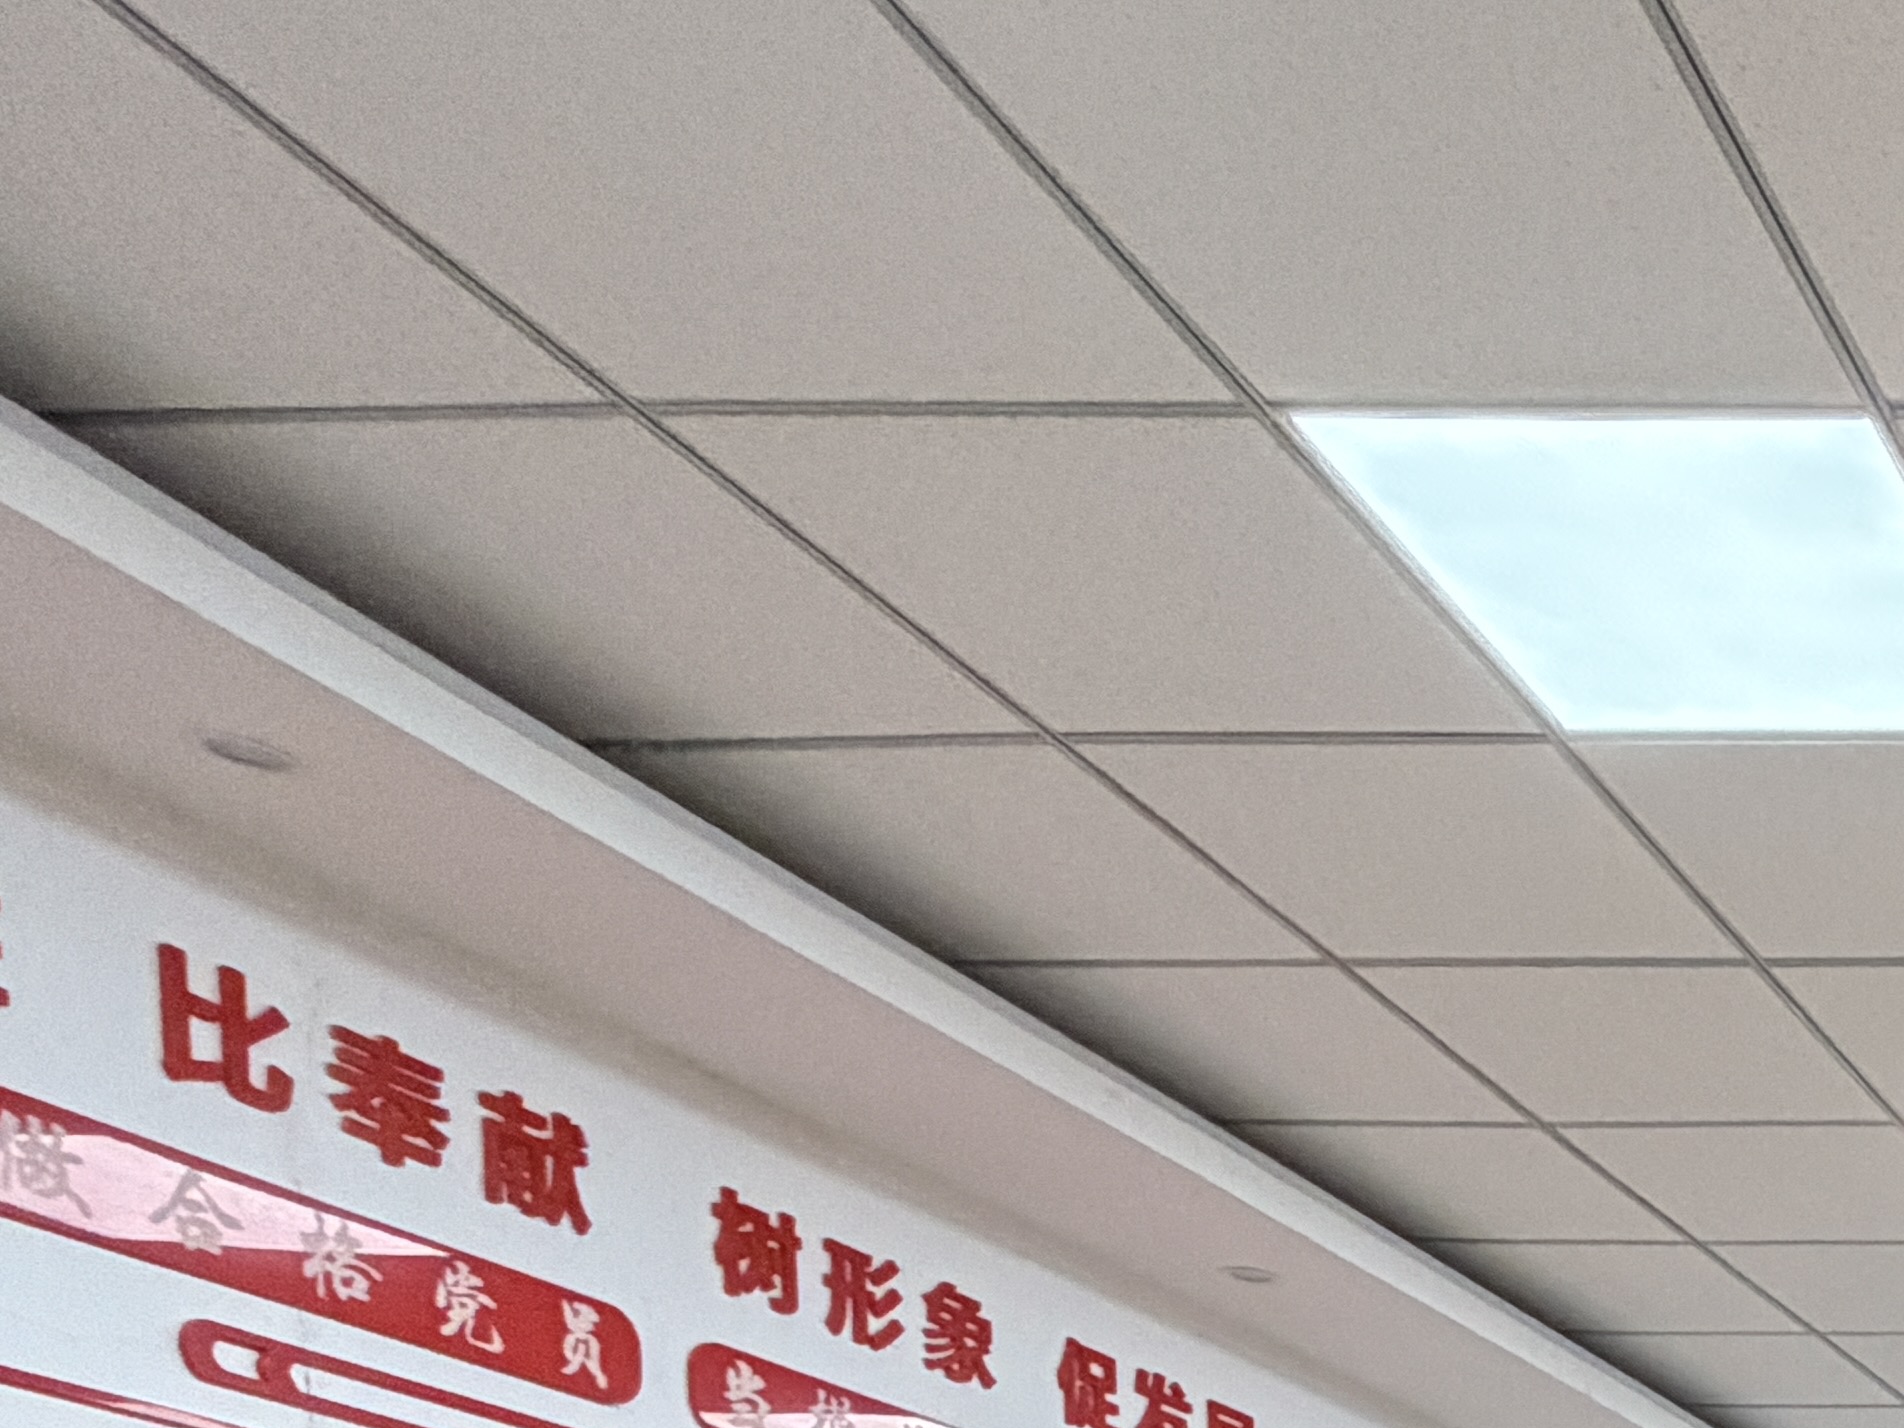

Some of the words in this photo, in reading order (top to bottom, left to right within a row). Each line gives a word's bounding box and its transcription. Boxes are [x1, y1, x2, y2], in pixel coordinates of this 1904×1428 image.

[156, 942, 592, 1235] 比奉献
[711, 1187, 998, 1390] 树形象
